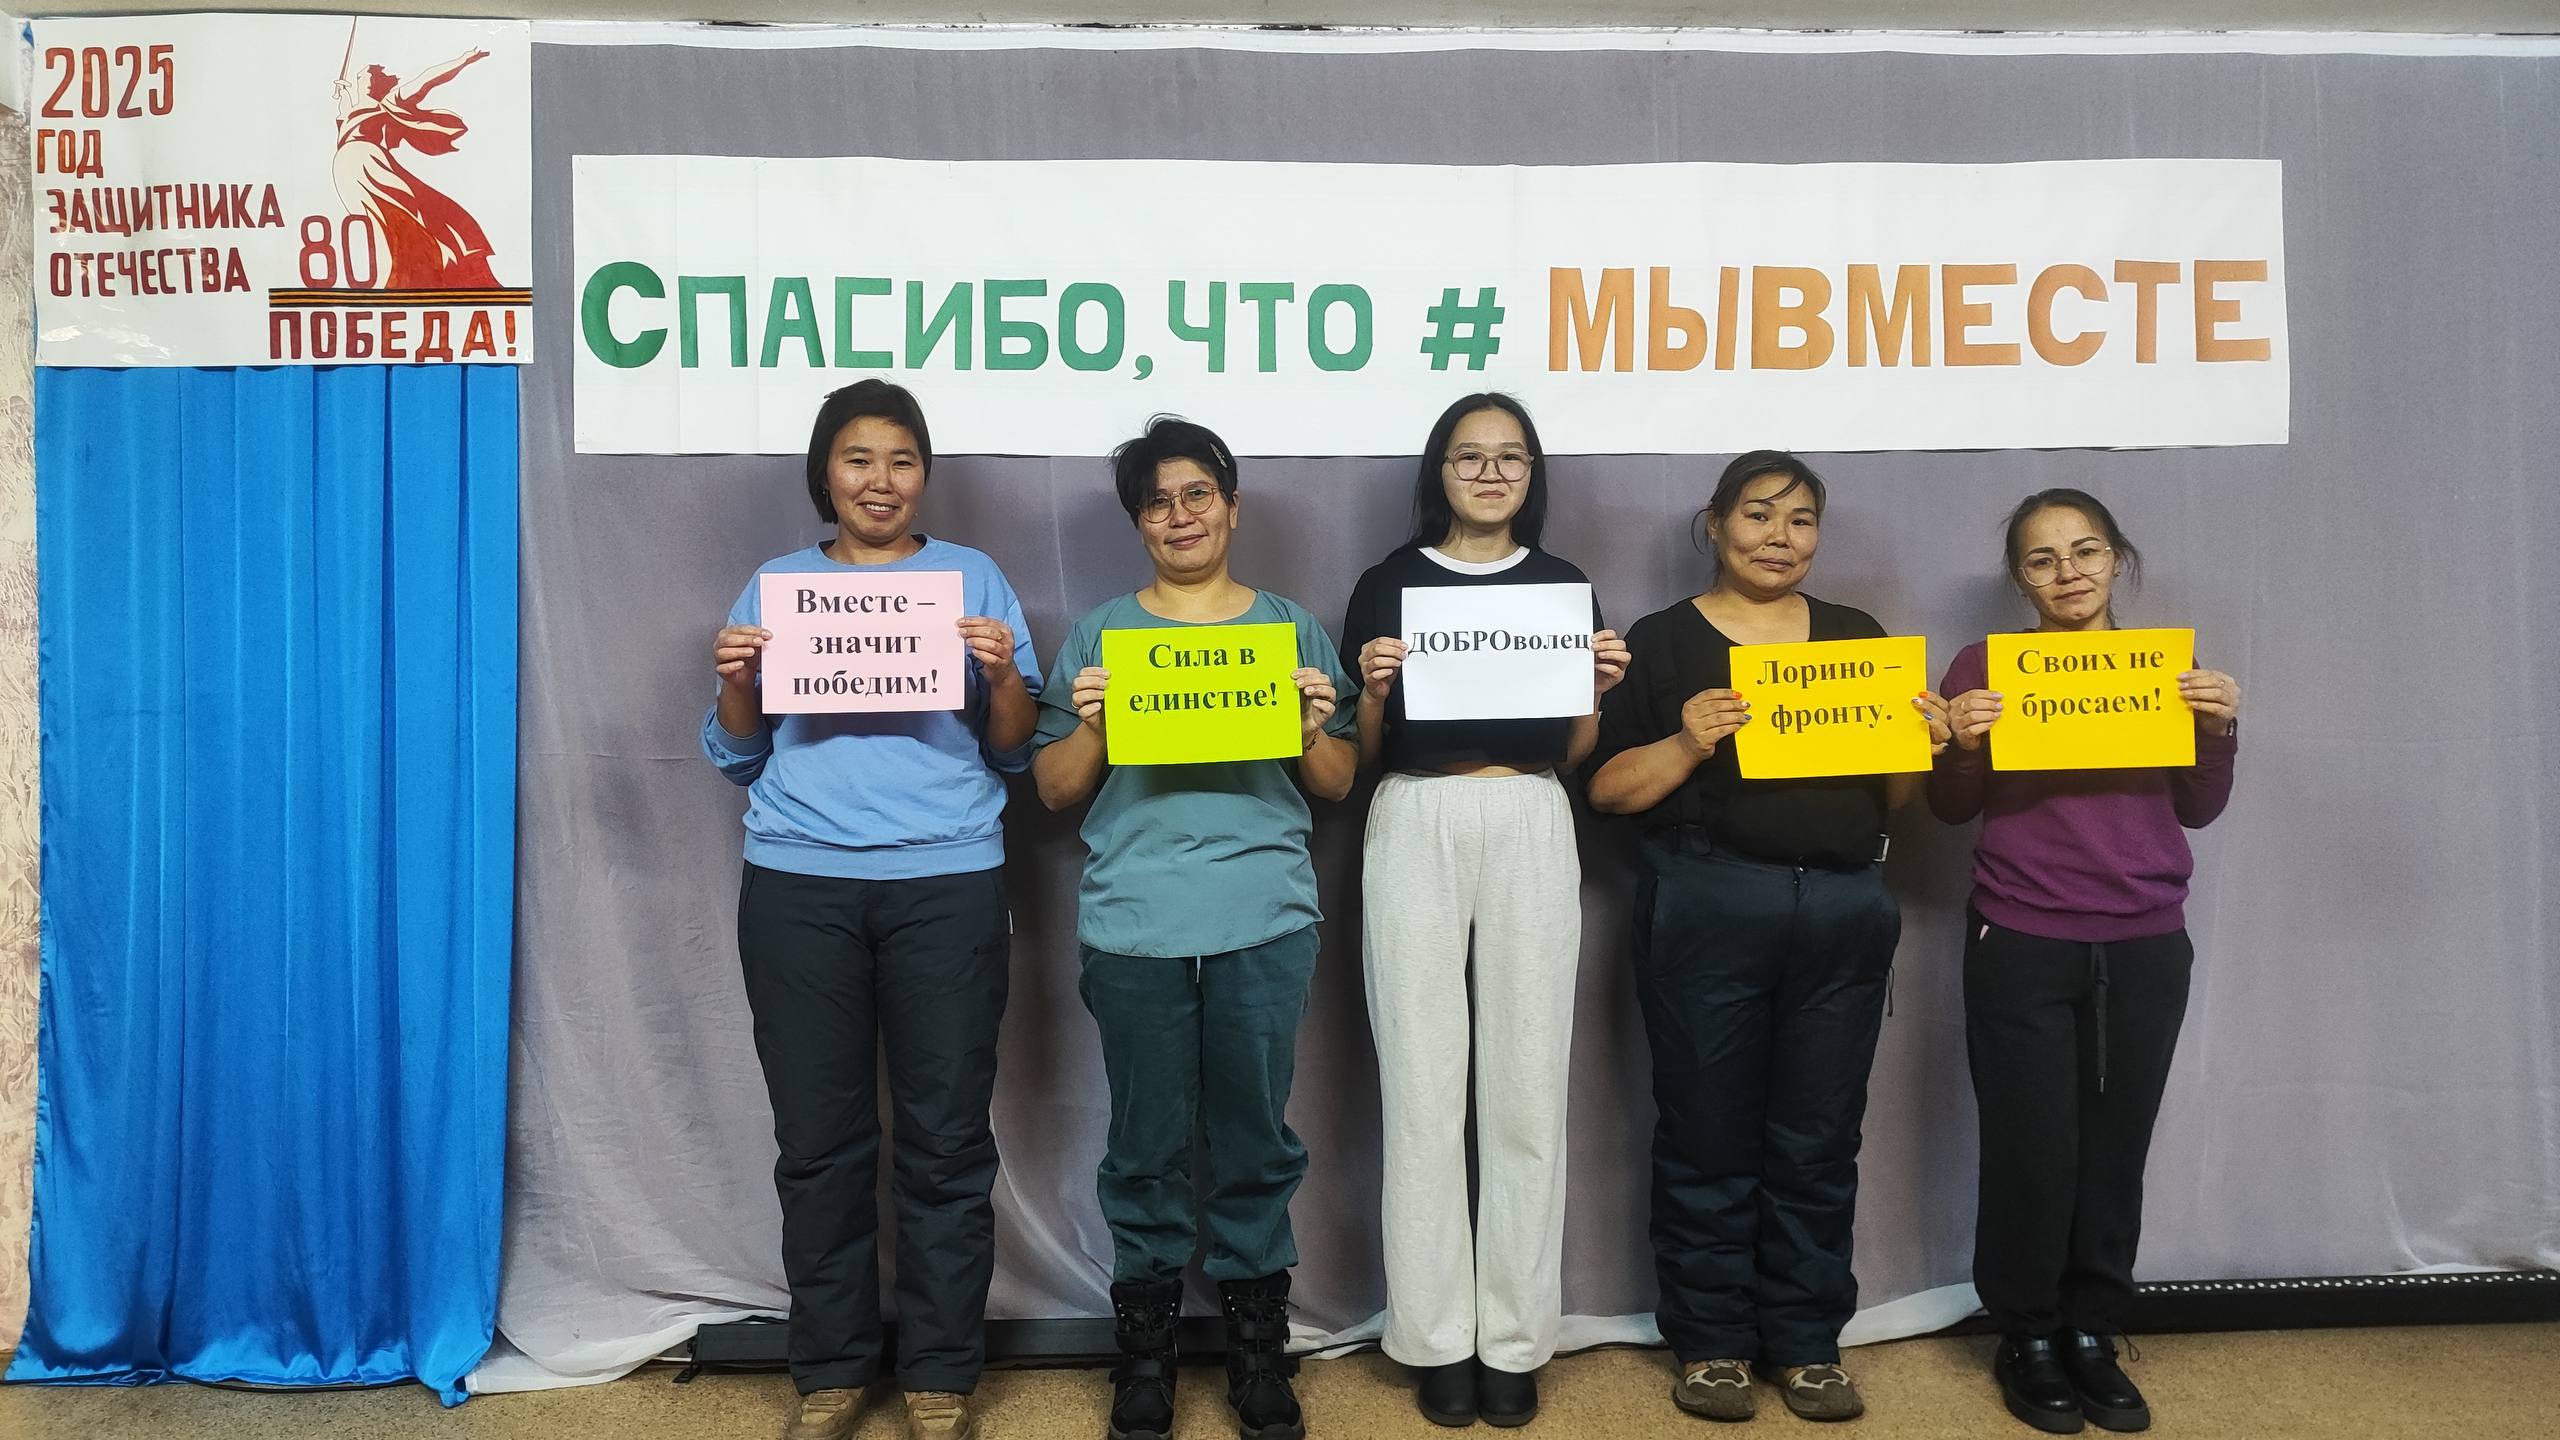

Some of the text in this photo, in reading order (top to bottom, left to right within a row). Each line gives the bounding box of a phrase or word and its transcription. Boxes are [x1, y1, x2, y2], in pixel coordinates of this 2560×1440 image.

[42, 45, 173, 118] 2025
[37, 129, 103, 178] ГОД
[48, 184, 284, 237] ЗАЩИТНИКА
[300, 214, 377, 289] 80
[51, 248, 250, 296] ОТЕЧЕСТВА
[1548, 260, 2271, 372] МЫВМЕСТЕ
[270, 310, 516, 362] ПОБЕДА!
[795, 588, 908, 614] Вместе
[809, 635, 922, 655] значит
[1148, 644, 1257, 669] Сила в
[1408, 629, 1590, 658] ДОБРОволец
[1757, 661, 1874, 689] Лорино
[2018, 650, 2165, 674] Своих не
[792, 668, 938, 698] победим!
[1130, 682, 1277, 713] единстве!
[1771, 705, 1892, 734] фронту.
[2022, 688, 2160, 723] бросаем!
